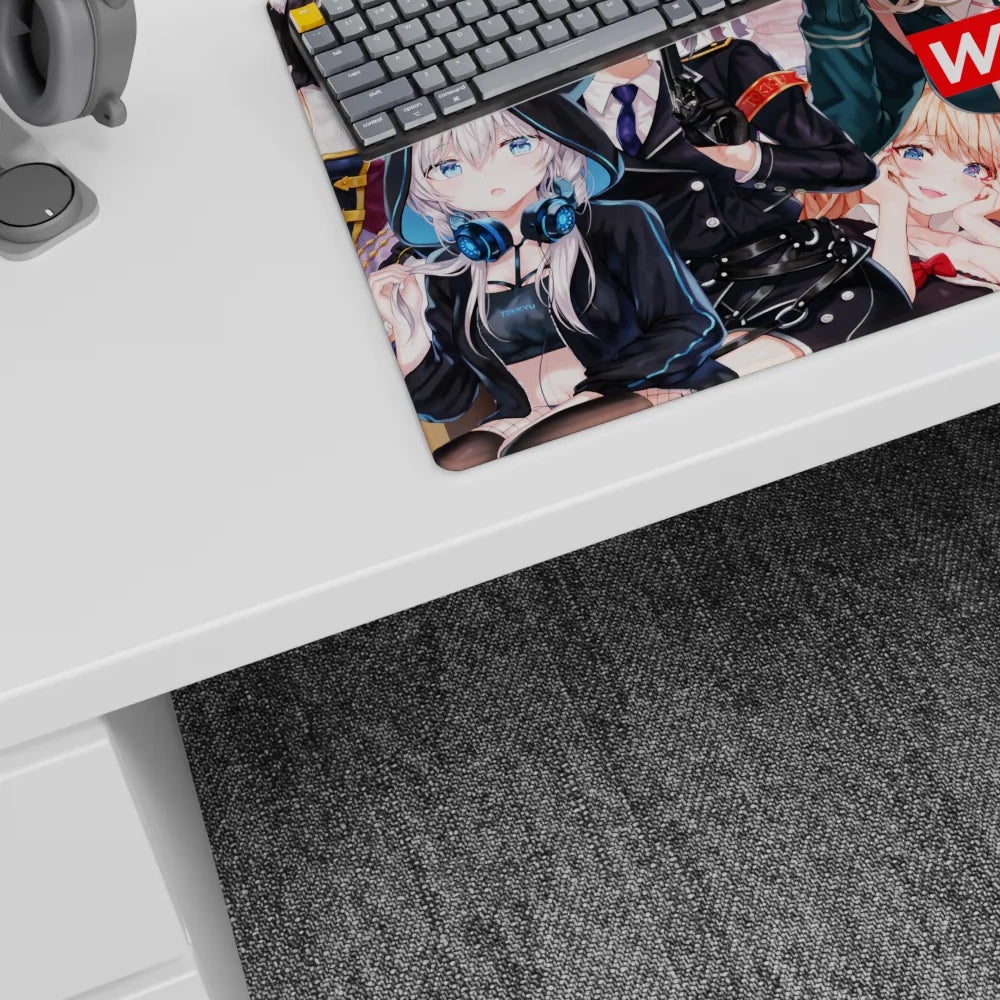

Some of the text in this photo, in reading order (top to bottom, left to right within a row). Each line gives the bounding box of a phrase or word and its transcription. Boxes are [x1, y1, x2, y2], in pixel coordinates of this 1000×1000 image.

[332, 49, 343, 57] tab
[368, 88, 382, 98] shift
[438, 84, 467, 99] command
[403, 101, 423, 113] option
[362, 116, 383, 129] control
